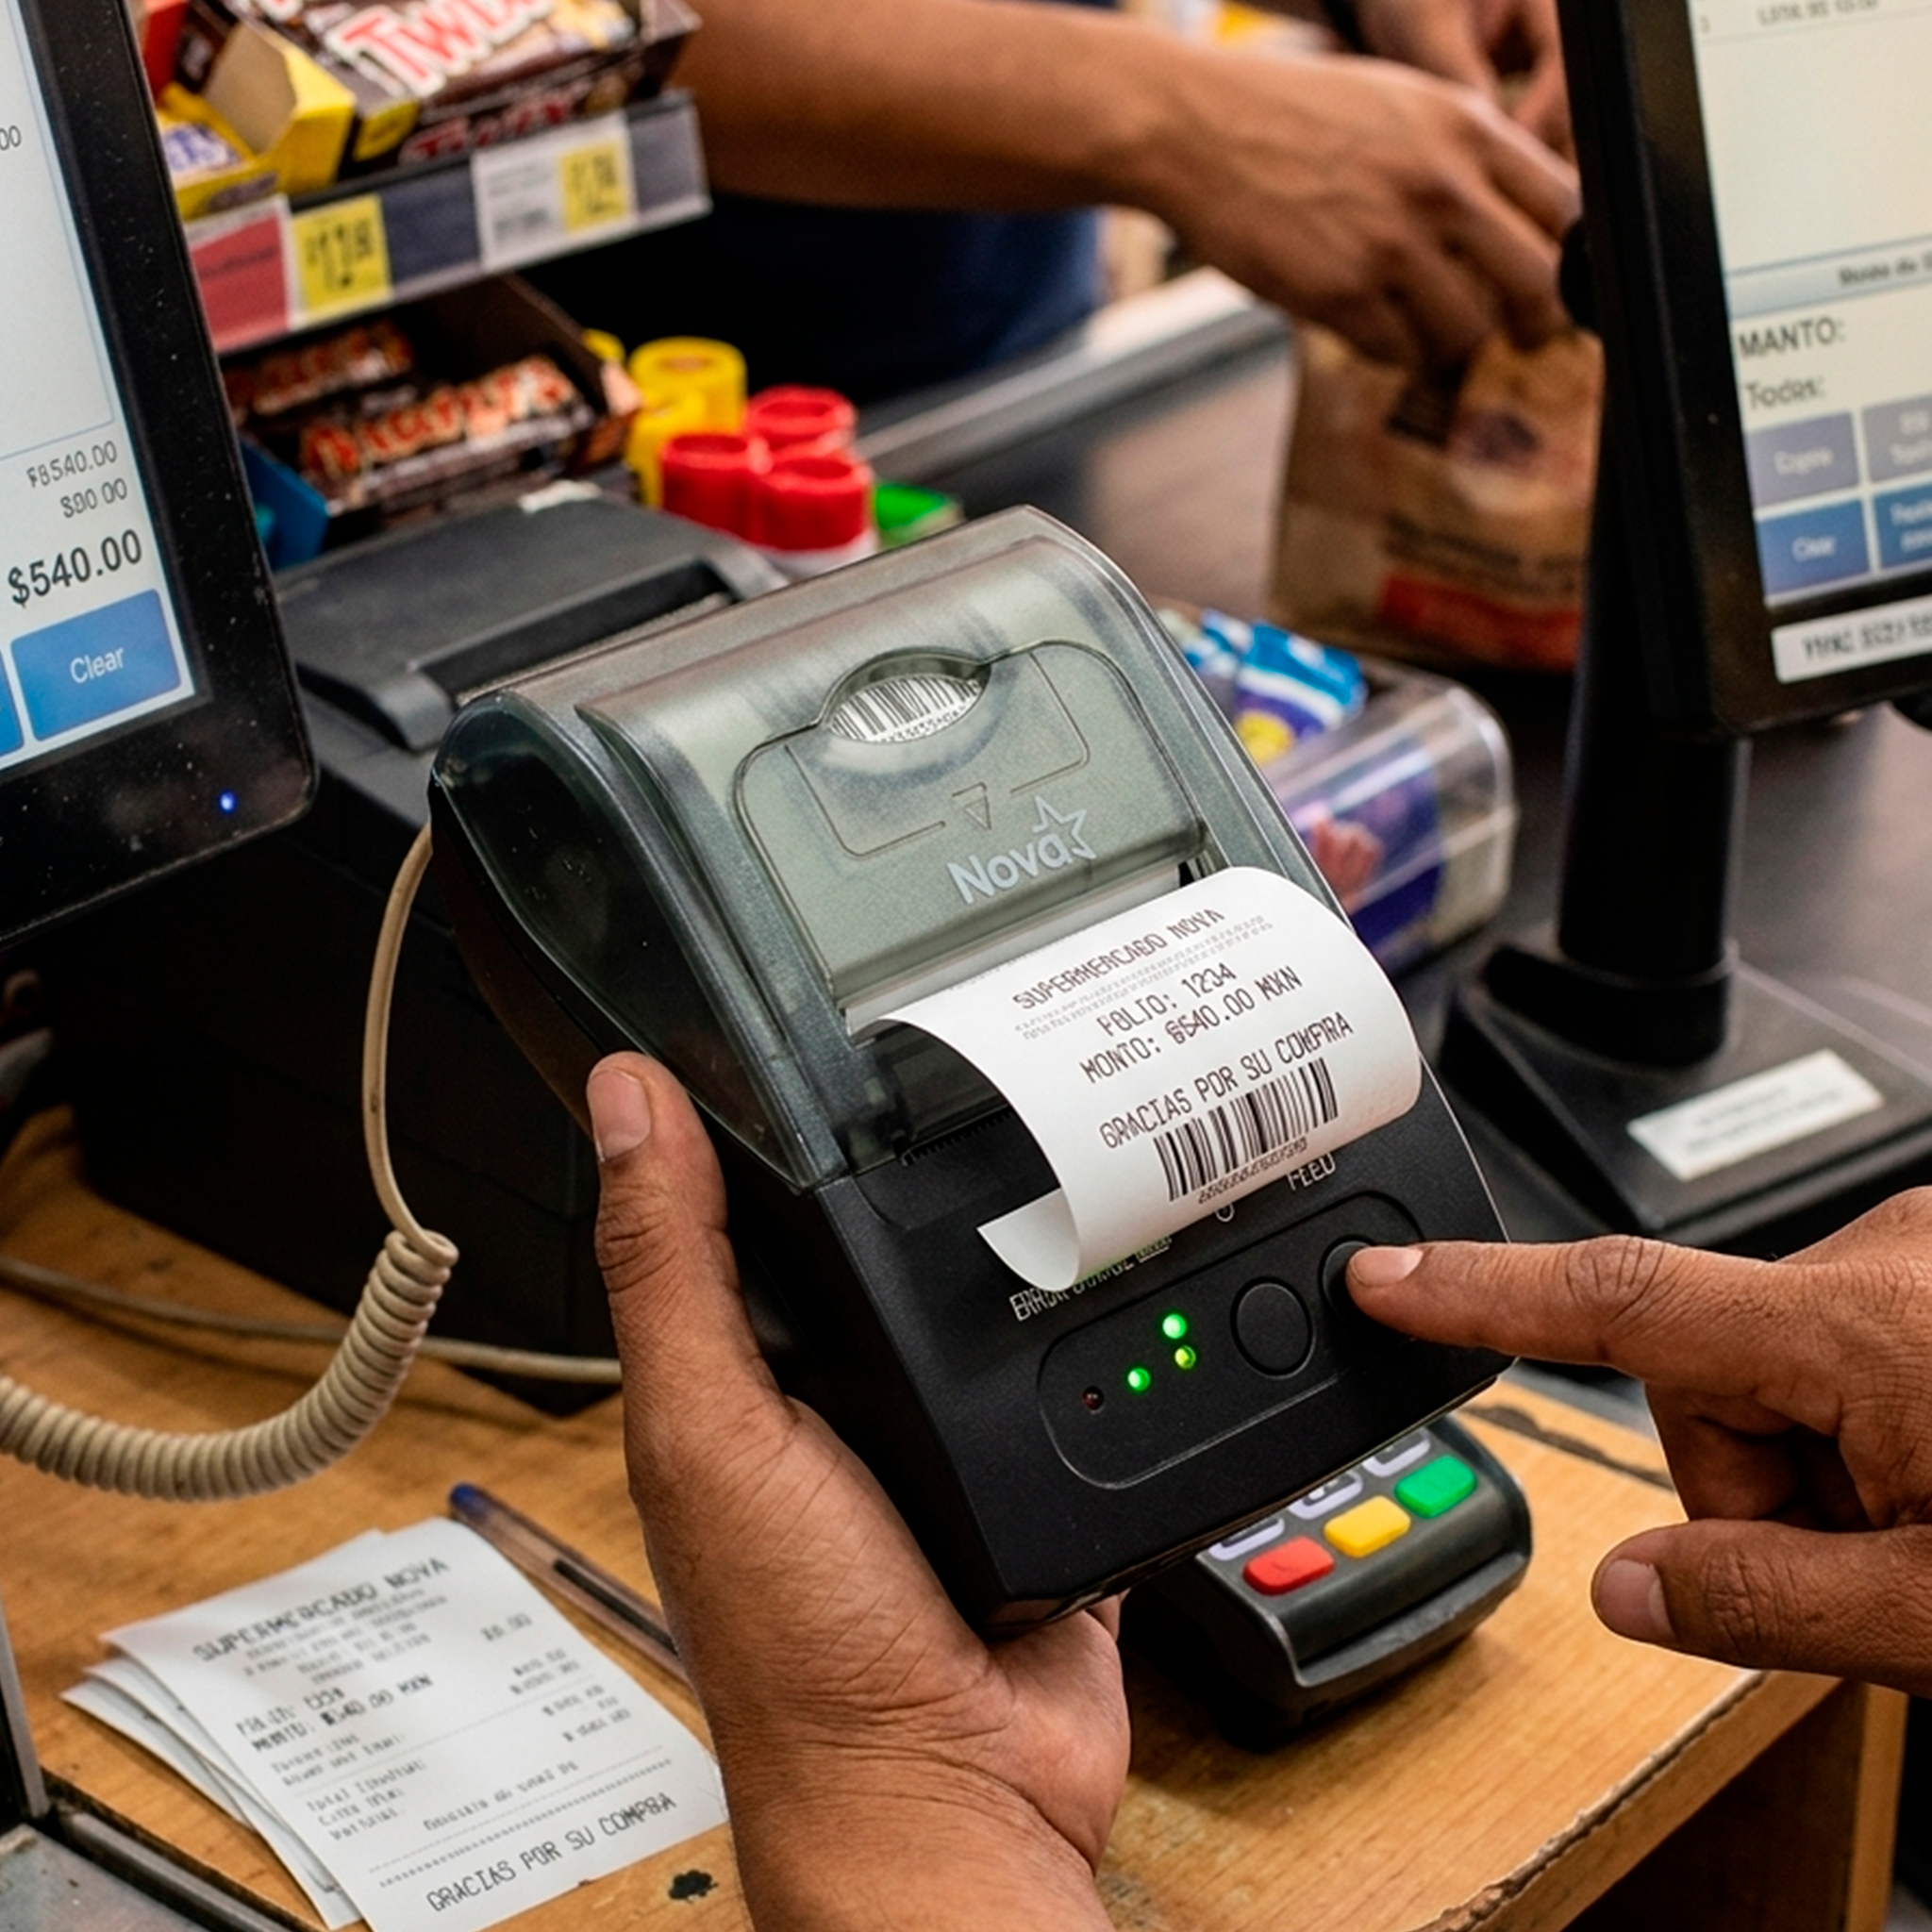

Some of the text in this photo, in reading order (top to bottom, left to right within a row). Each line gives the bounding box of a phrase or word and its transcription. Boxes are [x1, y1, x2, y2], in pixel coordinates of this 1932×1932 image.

[8, 529, 142, 608] $540.00
[70, 647, 124, 683] Clear
[947, 833, 1074, 904] Nova
[1080, 1037, 1161, 1084] MONTO:
[1099, 1088, 1192, 1149] GRACIAS
[1194, 1066, 1238, 1103] POR
[1240, 1049, 1273, 1081] SU
[425, 1860, 516, 1913] GRACIAS
[520, 1840, 562, 1871] POR
[565, 1828, 595, 1852] SU
